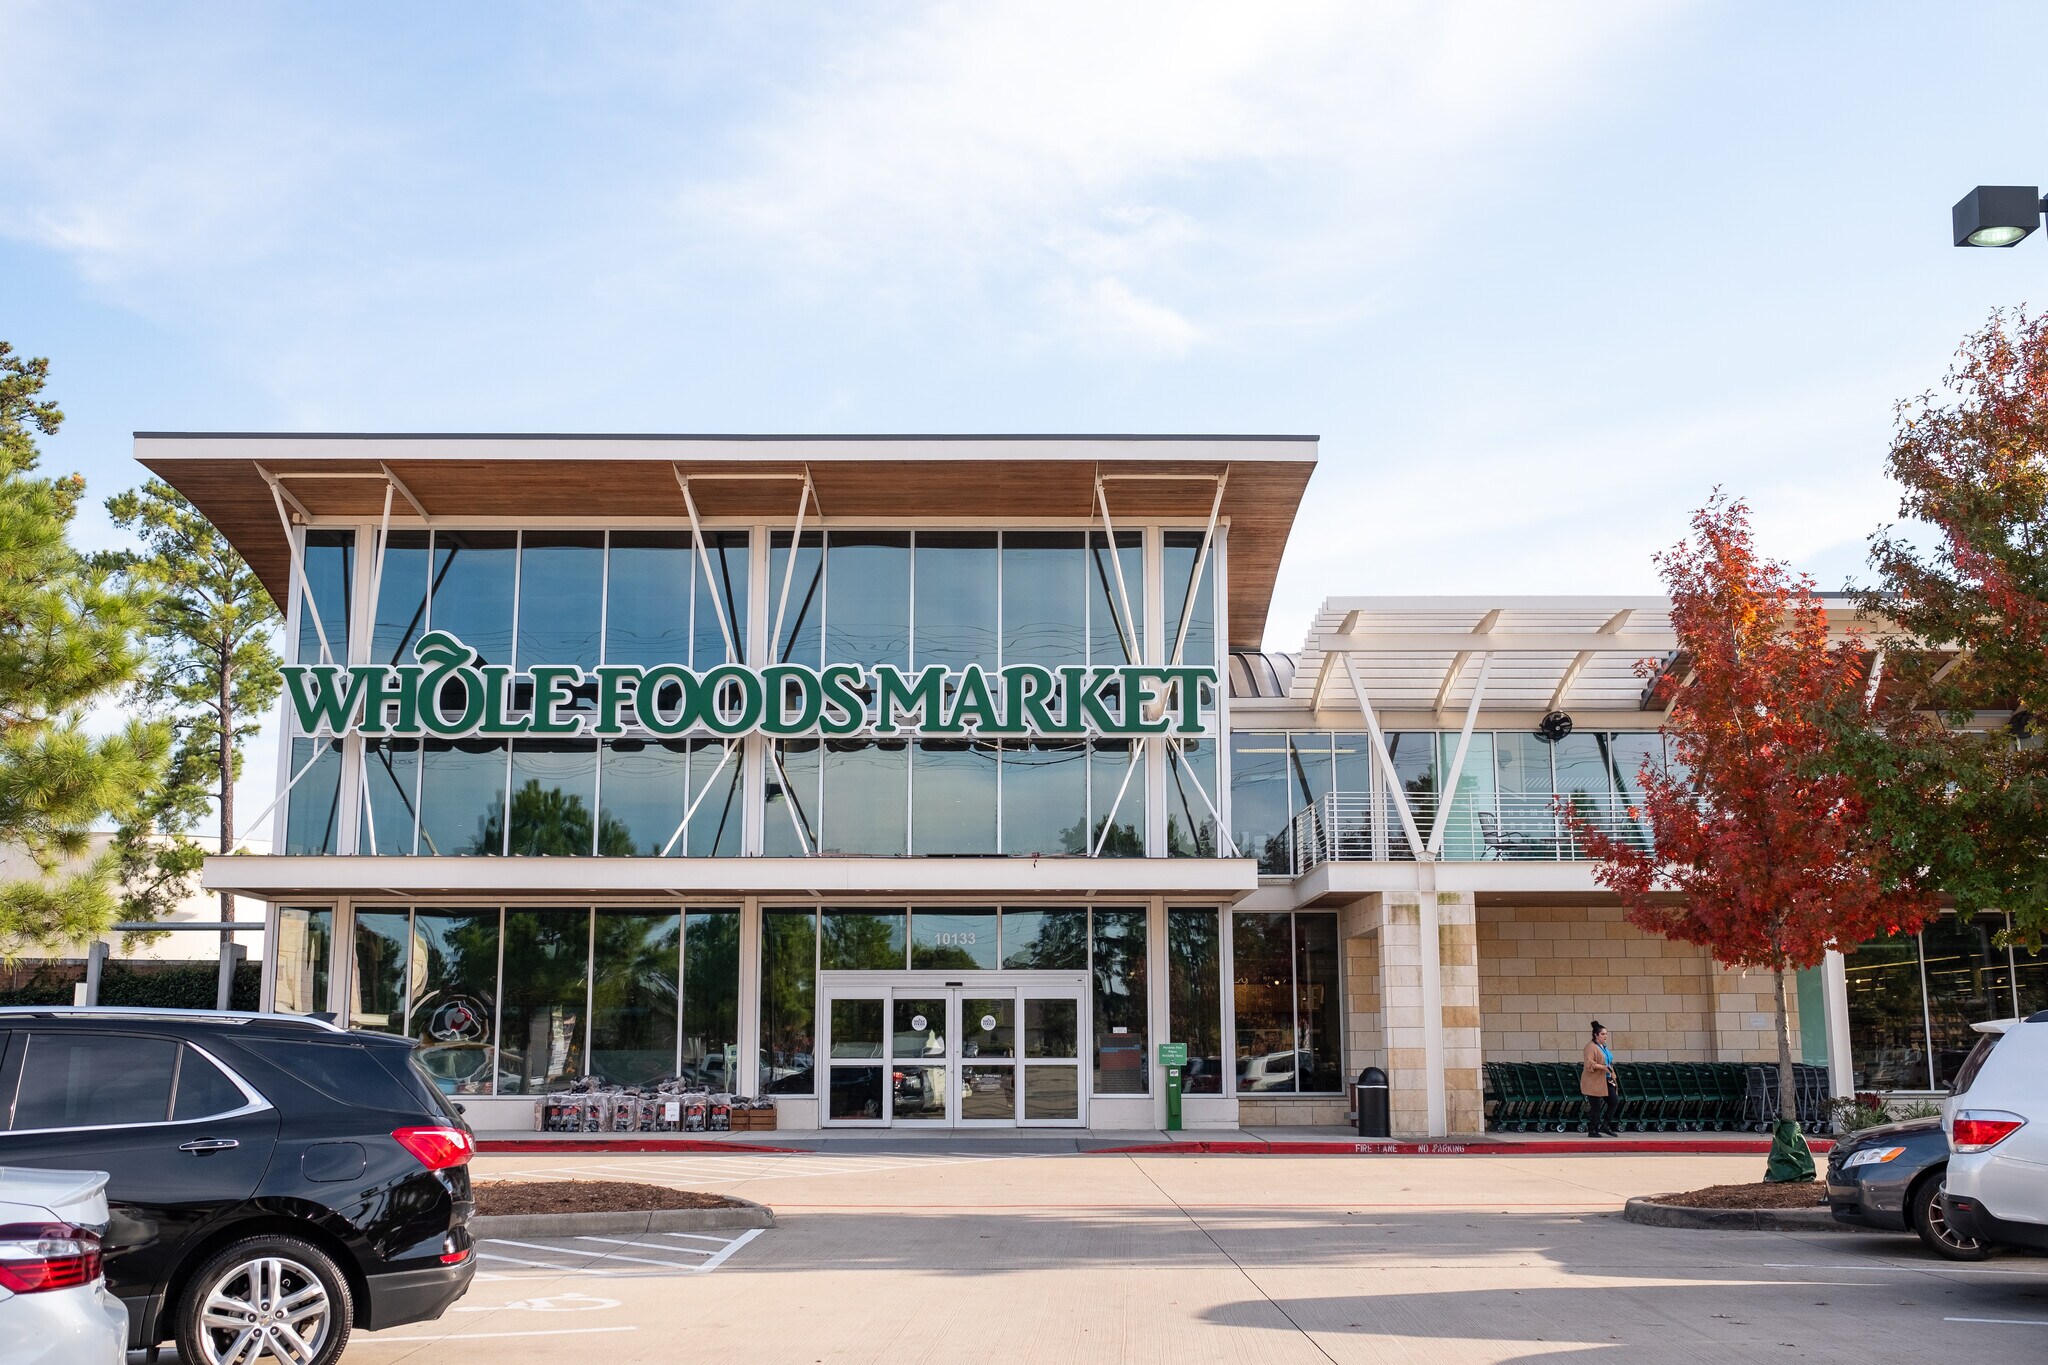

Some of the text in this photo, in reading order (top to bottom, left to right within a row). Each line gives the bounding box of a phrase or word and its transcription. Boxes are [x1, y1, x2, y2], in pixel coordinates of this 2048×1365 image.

[280, 634, 1220, 740] WHOLE FOODS MARKET
[934, 932, 976, 945] 10133
[1355, 1144, 1373, 1153] FIRE
[1418, 1144, 1429, 1153] NO
[1431, 1144, 1465, 1153] PARKING
